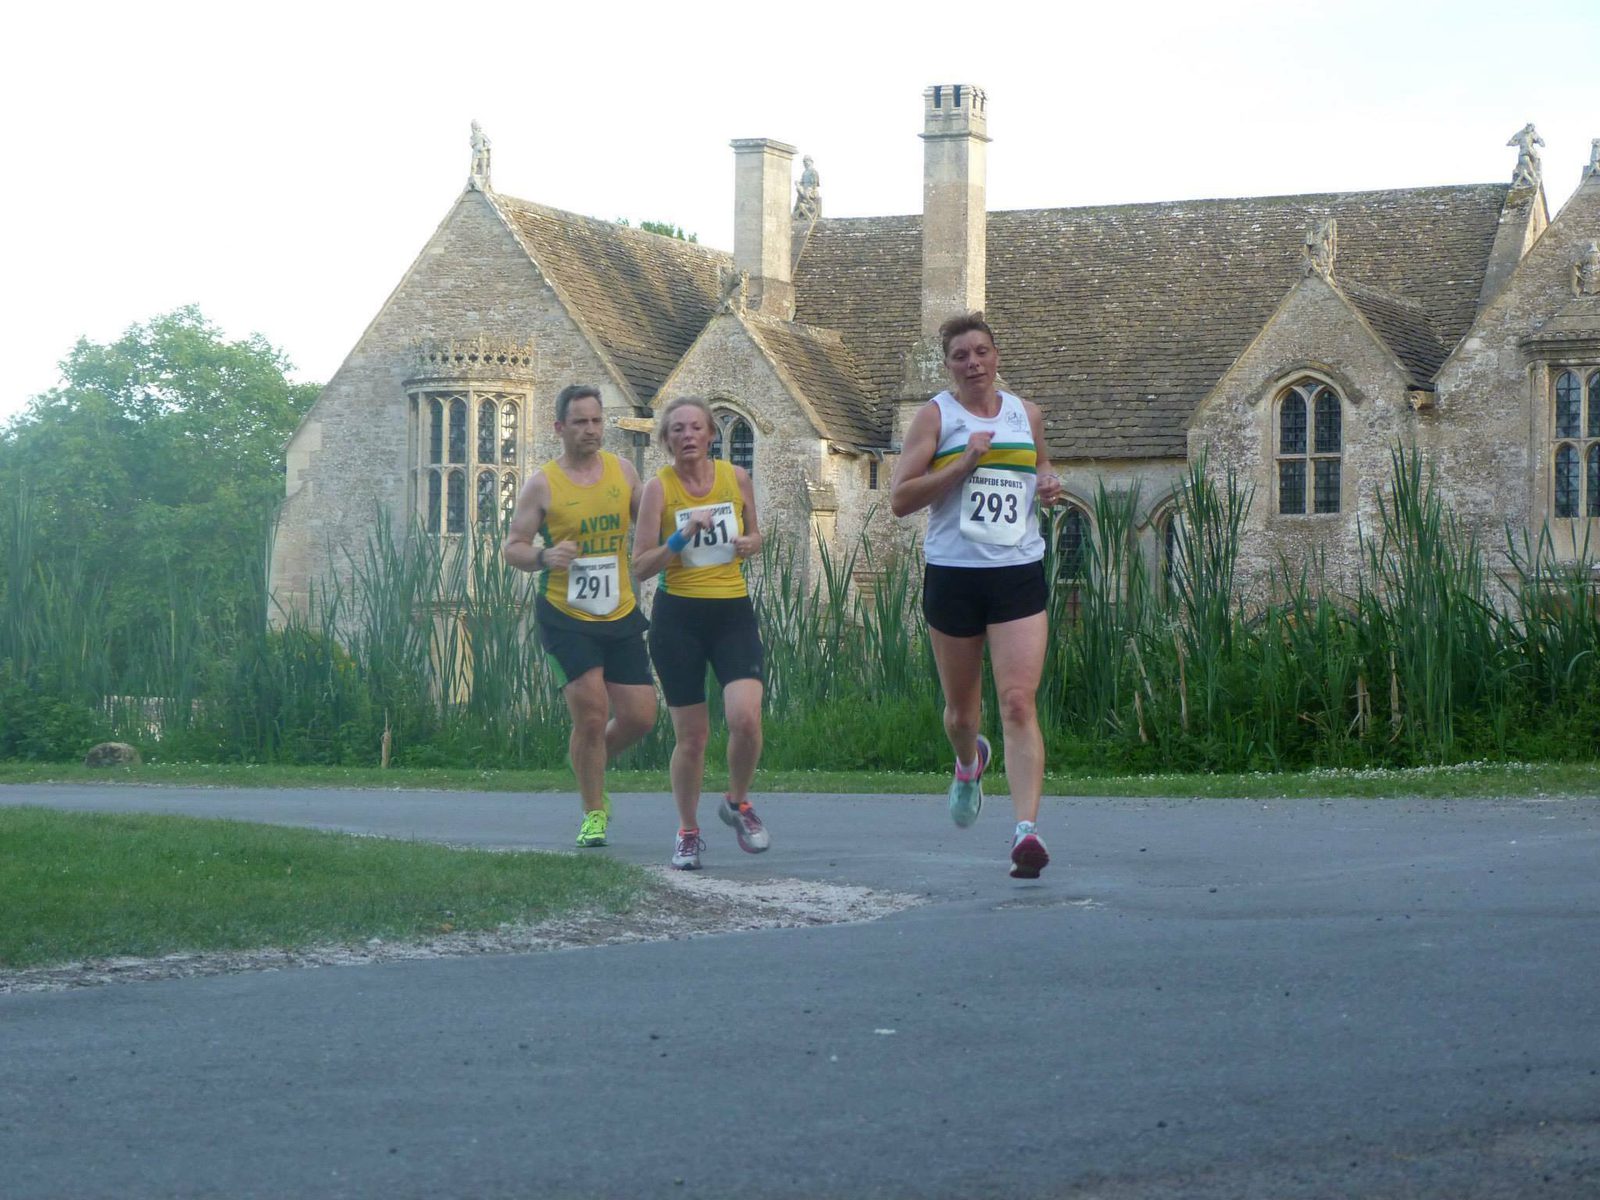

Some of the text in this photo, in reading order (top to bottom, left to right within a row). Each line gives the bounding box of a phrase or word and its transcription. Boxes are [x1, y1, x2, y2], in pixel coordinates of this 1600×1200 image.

[1001, 480, 1022, 489] SPORTS
[970, 491, 1017, 523] 293
[581, 513, 620, 534] AVON
[576, 576, 609, 599] 291
